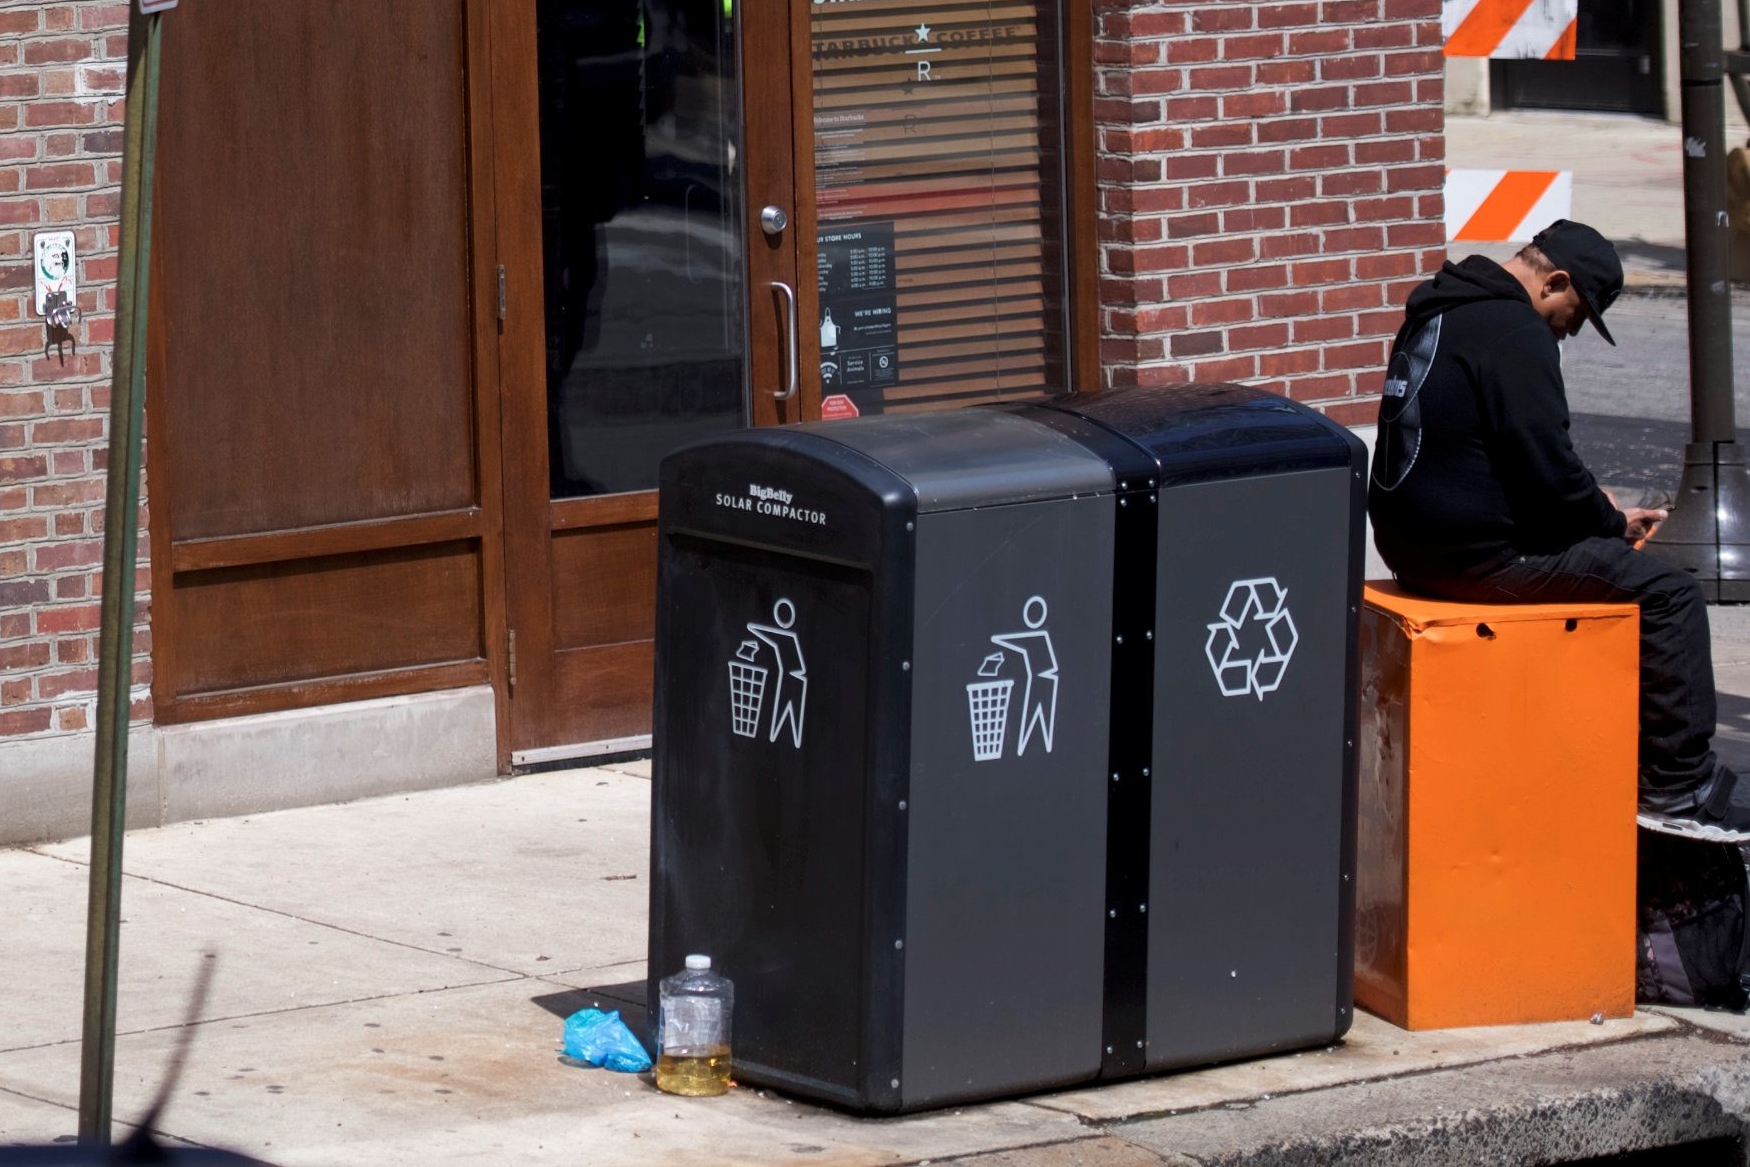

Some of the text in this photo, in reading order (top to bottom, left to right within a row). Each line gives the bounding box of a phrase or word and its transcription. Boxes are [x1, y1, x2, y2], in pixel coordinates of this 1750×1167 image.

[749, 484, 793, 505] BigBelly
[716, 493, 827, 526] SOLAR COMPACTOR
